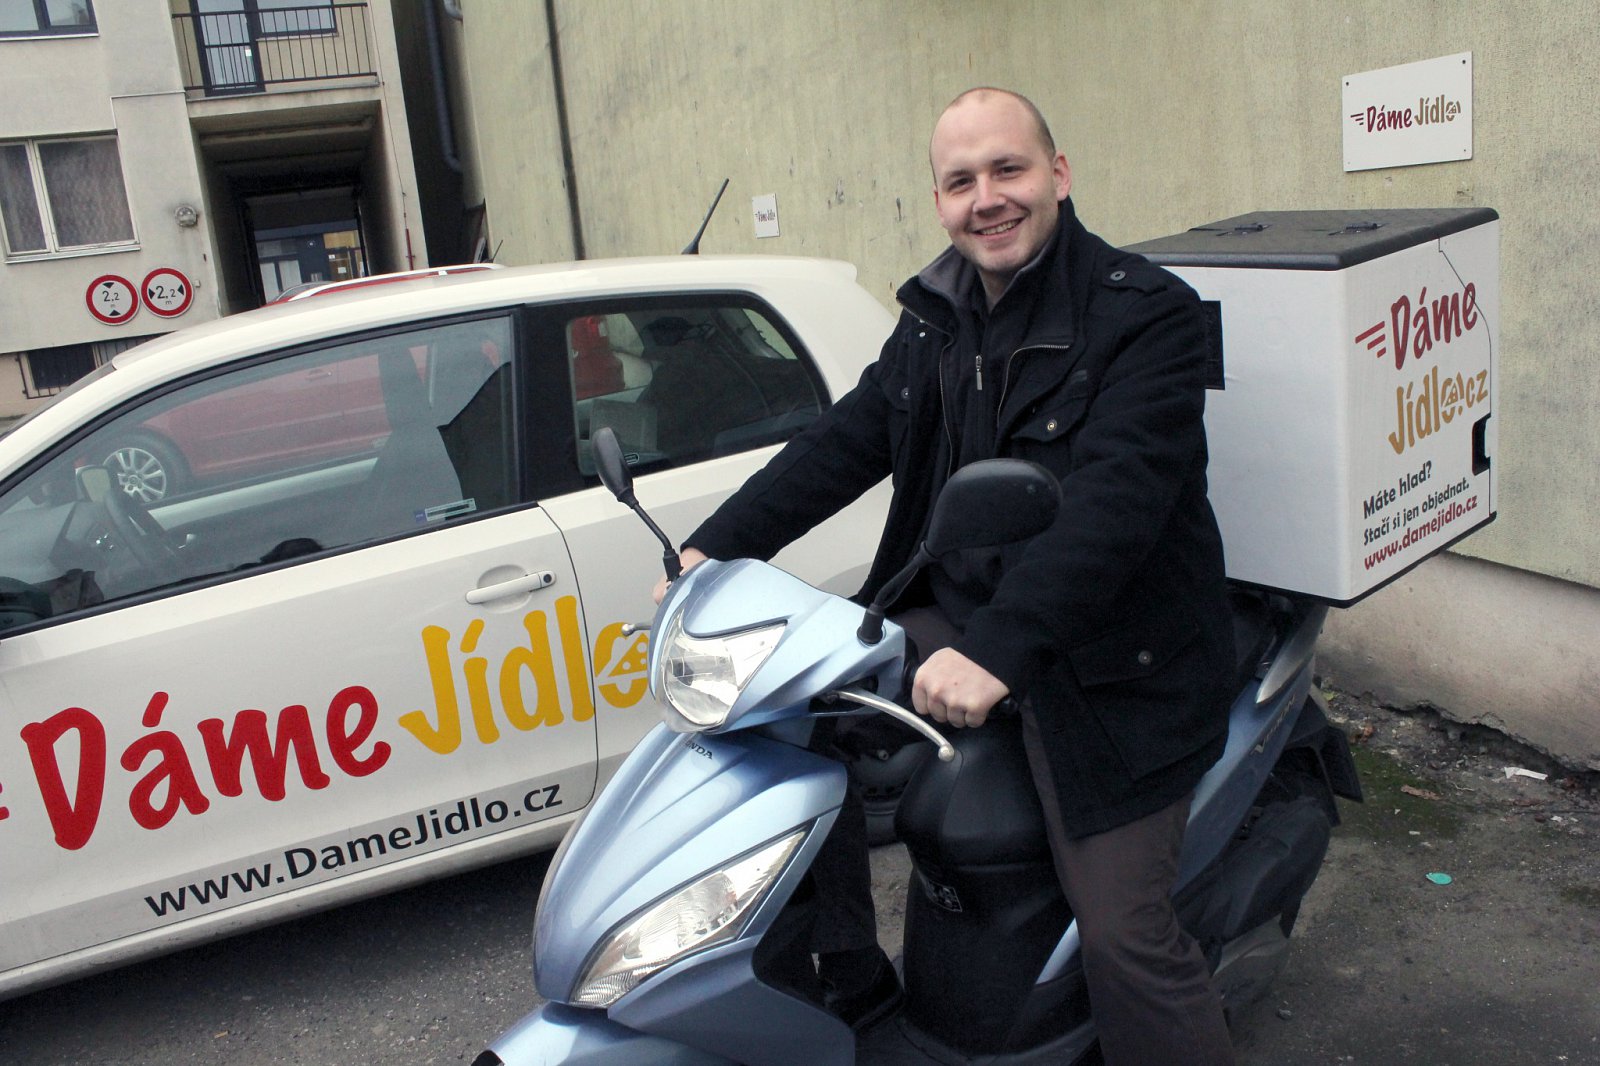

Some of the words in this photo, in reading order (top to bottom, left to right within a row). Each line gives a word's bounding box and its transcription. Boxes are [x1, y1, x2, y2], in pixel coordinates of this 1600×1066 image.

[1366, 104, 1413, 133] Dáme
[1414, 94, 1461, 126] Jídlo
[1390, 282, 1478, 371] Dáme
[1363, 487, 1396, 520] Máte
[1399, 459, 1432, 497] hlad?
[1363, 515, 1390, 546] Stačí
[1392, 511, 1400, 530] si
[1402, 505, 1419, 527] jen
[1421, 476, 1470, 514] objednat.
[1364, 494, 1478, 570] www.damejidlo.cz
[20, 684, 392, 851] Dáme
[144, 782, 563, 917] www.DameJidlo.cz
